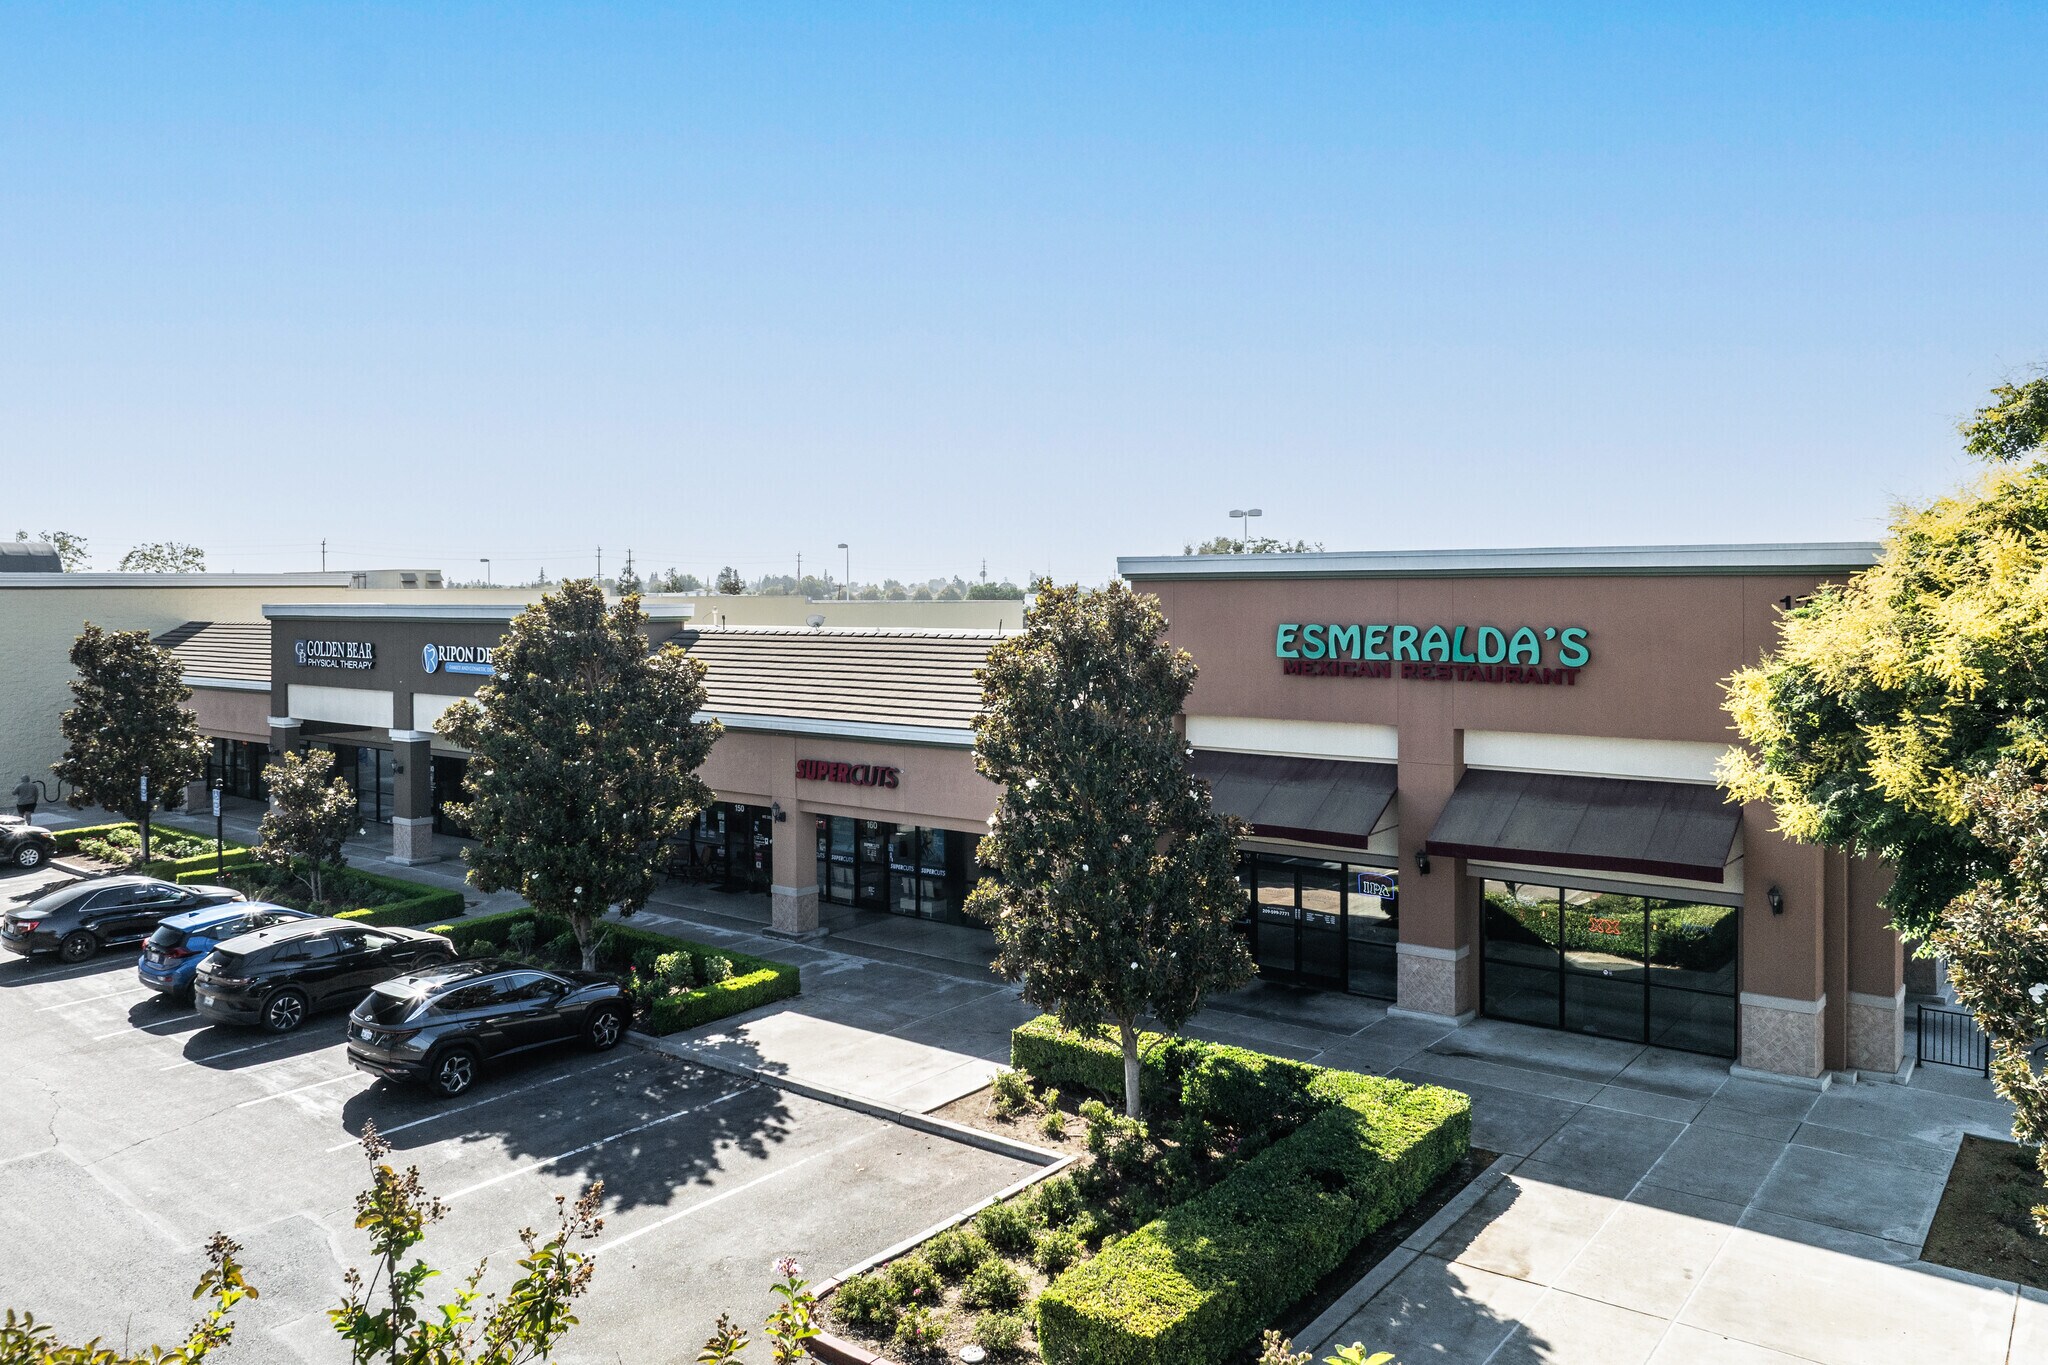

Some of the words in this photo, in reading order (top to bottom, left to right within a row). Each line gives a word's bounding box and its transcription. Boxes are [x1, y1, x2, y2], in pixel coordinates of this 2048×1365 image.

[307, 640, 345, 658] GOLDEN
[346, 642, 373, 659] BEAR
[1276, 624, 1590, 668] ESMERALDA'S
[438, 645, 474, 662] RIPON
[476, 647, 494, 664] DE
[308, 658, 339, 668] PHYSICAL
[340, 660, 373, 670] THERAPY
[1283, 660, 1392, 679] MEXICAN
[1400, 662, 1581, 686] RESTAURANT
[796, 759, 899, 789] SUPERCUTS
[734, 804, 745, 812] 150
[866, 820, 878, 830] 160
[831, 854, 854, 863] SUPERCUTS
[890, 863, 915, 872] SUPERCUTS
[921, 867, 946, 877] SUPERCUTS
